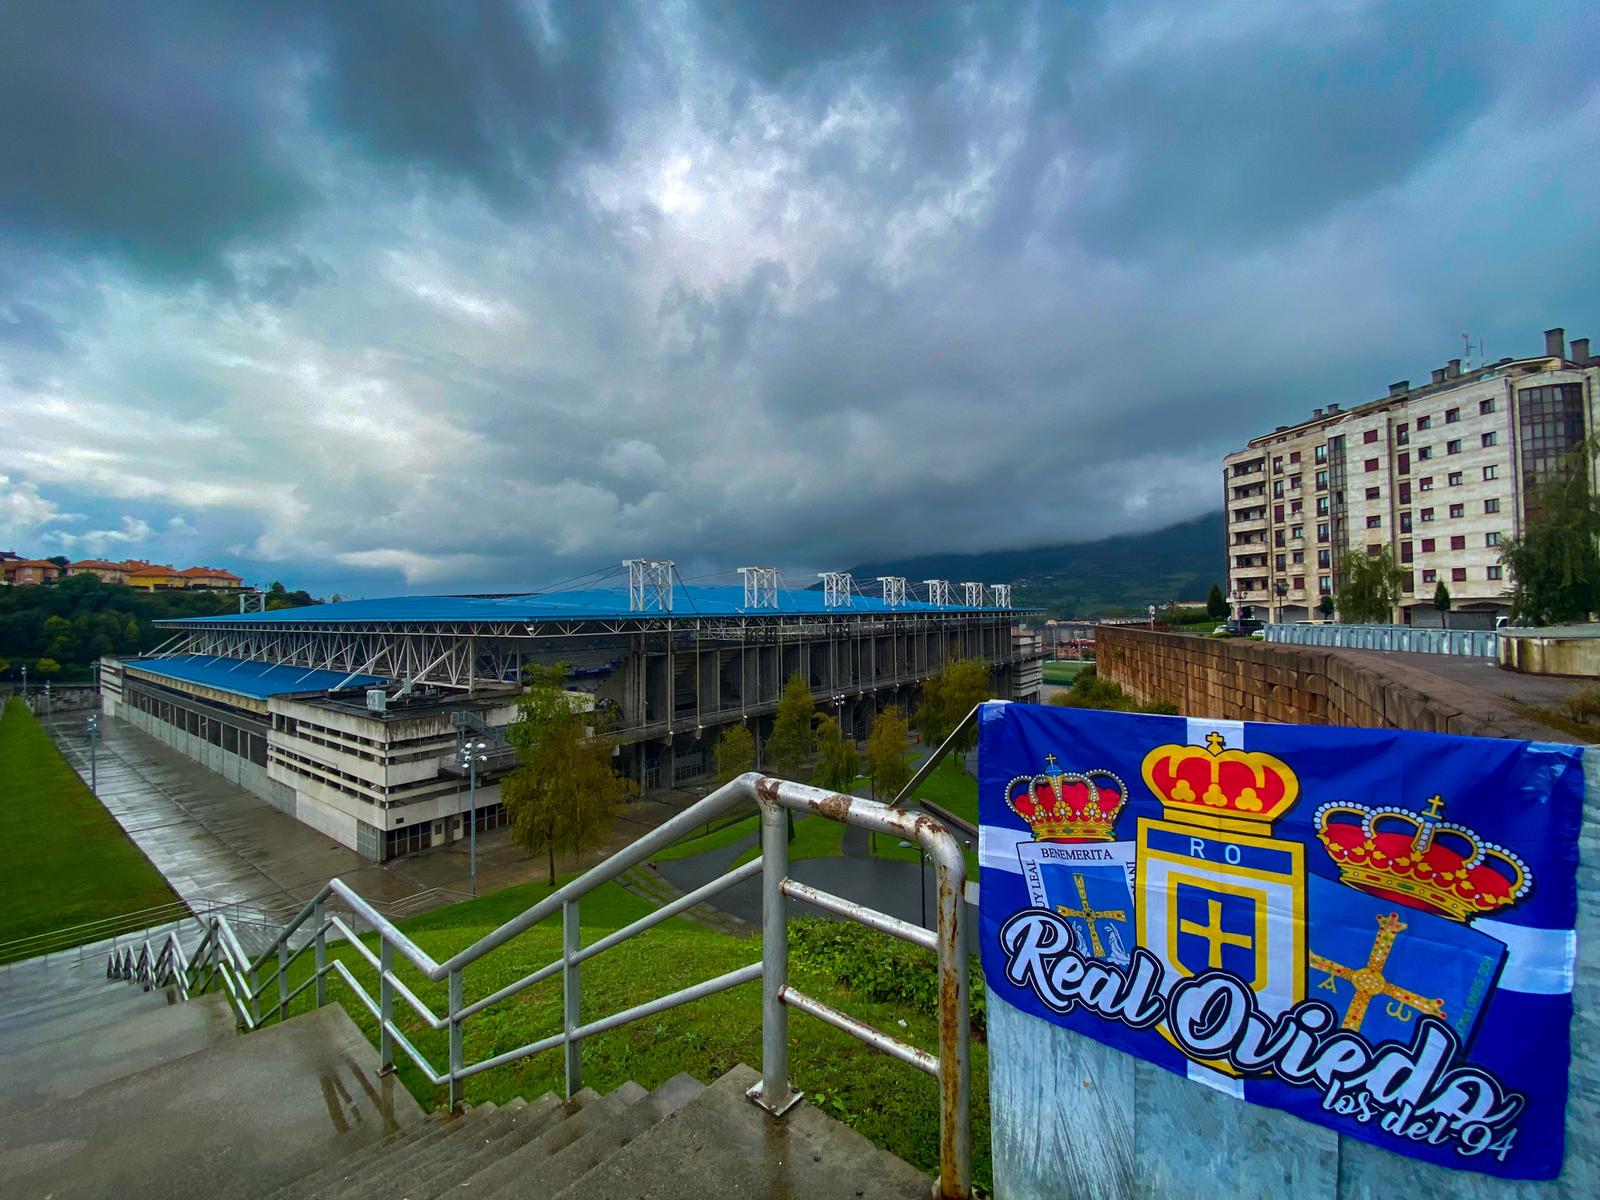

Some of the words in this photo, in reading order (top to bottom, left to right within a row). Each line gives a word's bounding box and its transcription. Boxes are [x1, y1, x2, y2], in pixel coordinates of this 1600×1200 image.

[1041, 847, 1114, 861] BENEMERITA
[1190, 837, 1206, 859] R
[1224, 844, 1241, 865] O
[1027, 859, 1042, 890] LEAL
[1034, 892, 1046, 908] UY
[1003, 912, 1164, 1026] Real
[1173, 976, 1519, 1125] Oviedo
[1321, 1078, 1378, 1122] los
[1380, 1102, 1451, 1145] del
[1456, 1124, 1519, 1162] 94
